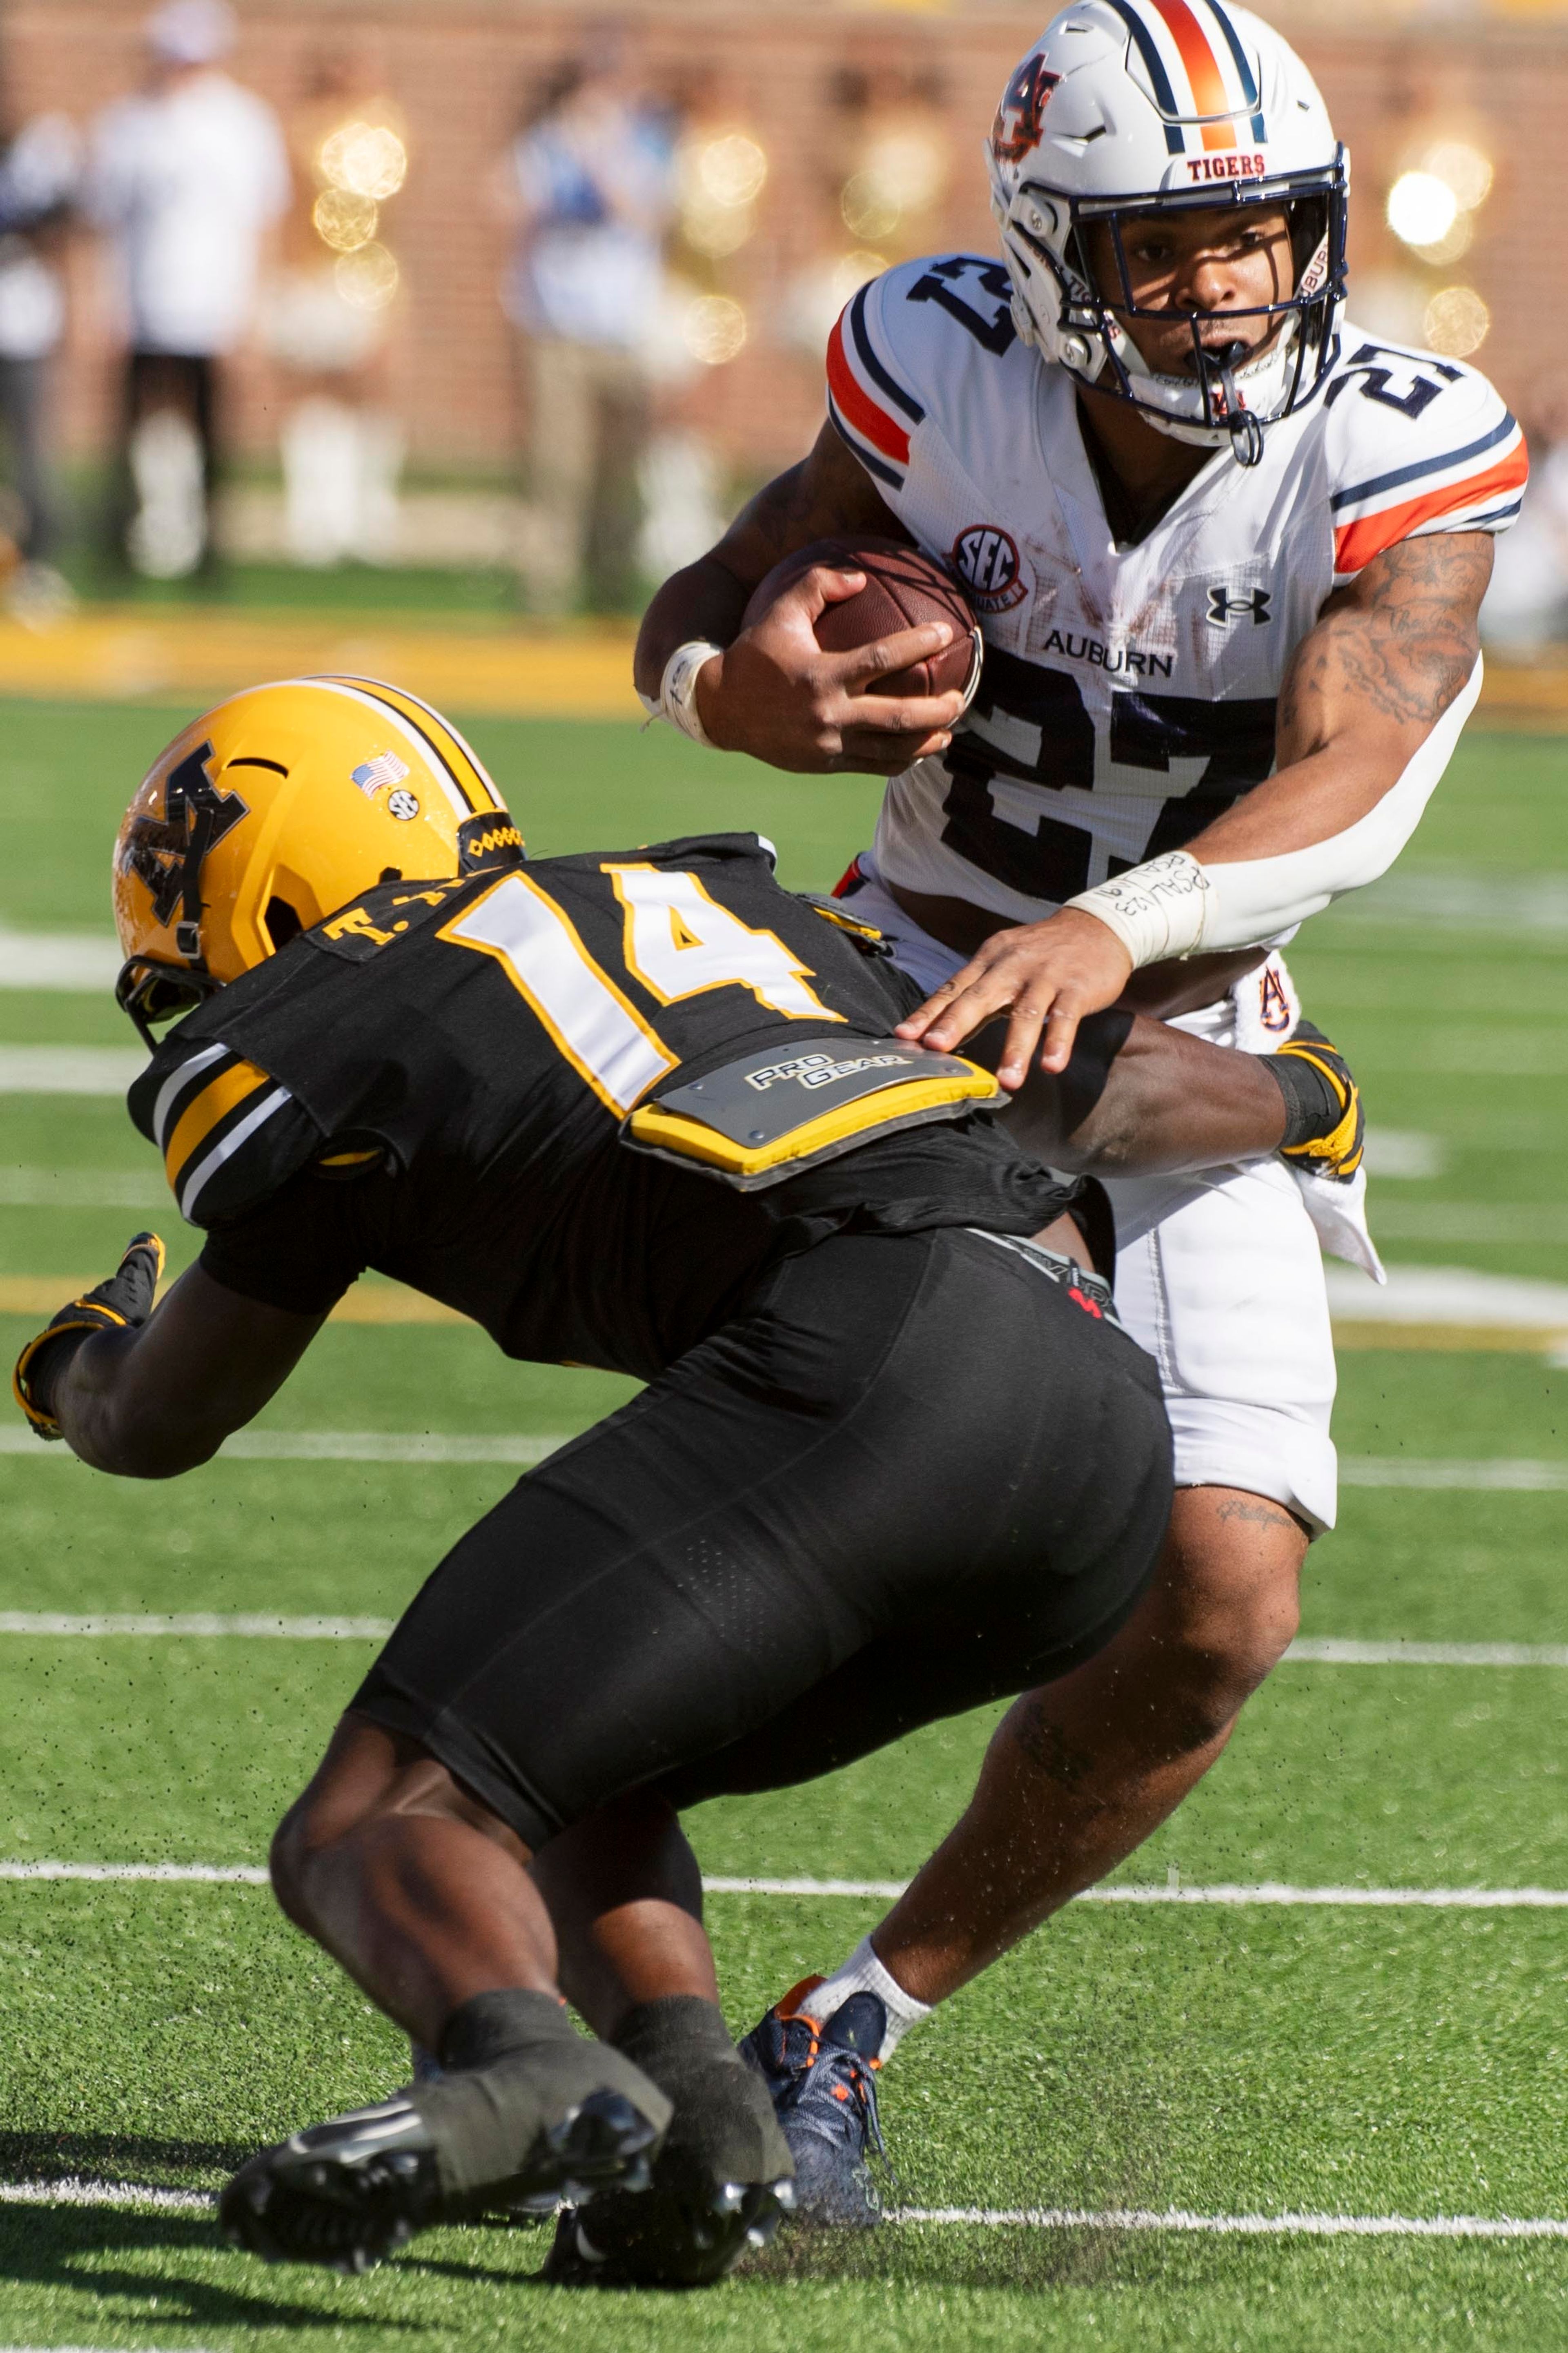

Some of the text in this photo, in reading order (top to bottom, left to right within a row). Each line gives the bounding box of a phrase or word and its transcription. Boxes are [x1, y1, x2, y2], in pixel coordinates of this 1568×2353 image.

[1187, 154, 1265, 181] TIGERS
[958, 530, 1014, 592] SEC
[1042, 629, 1173, 678] AUBURN
[942, 643, 1277, 905] 27
[388, 790, 419, 820] SEC
[434, 862, 849, 1121] 14
[749, 1054, 832, 1088] PRO
[800, 1056, 907, 1087] GEAR
